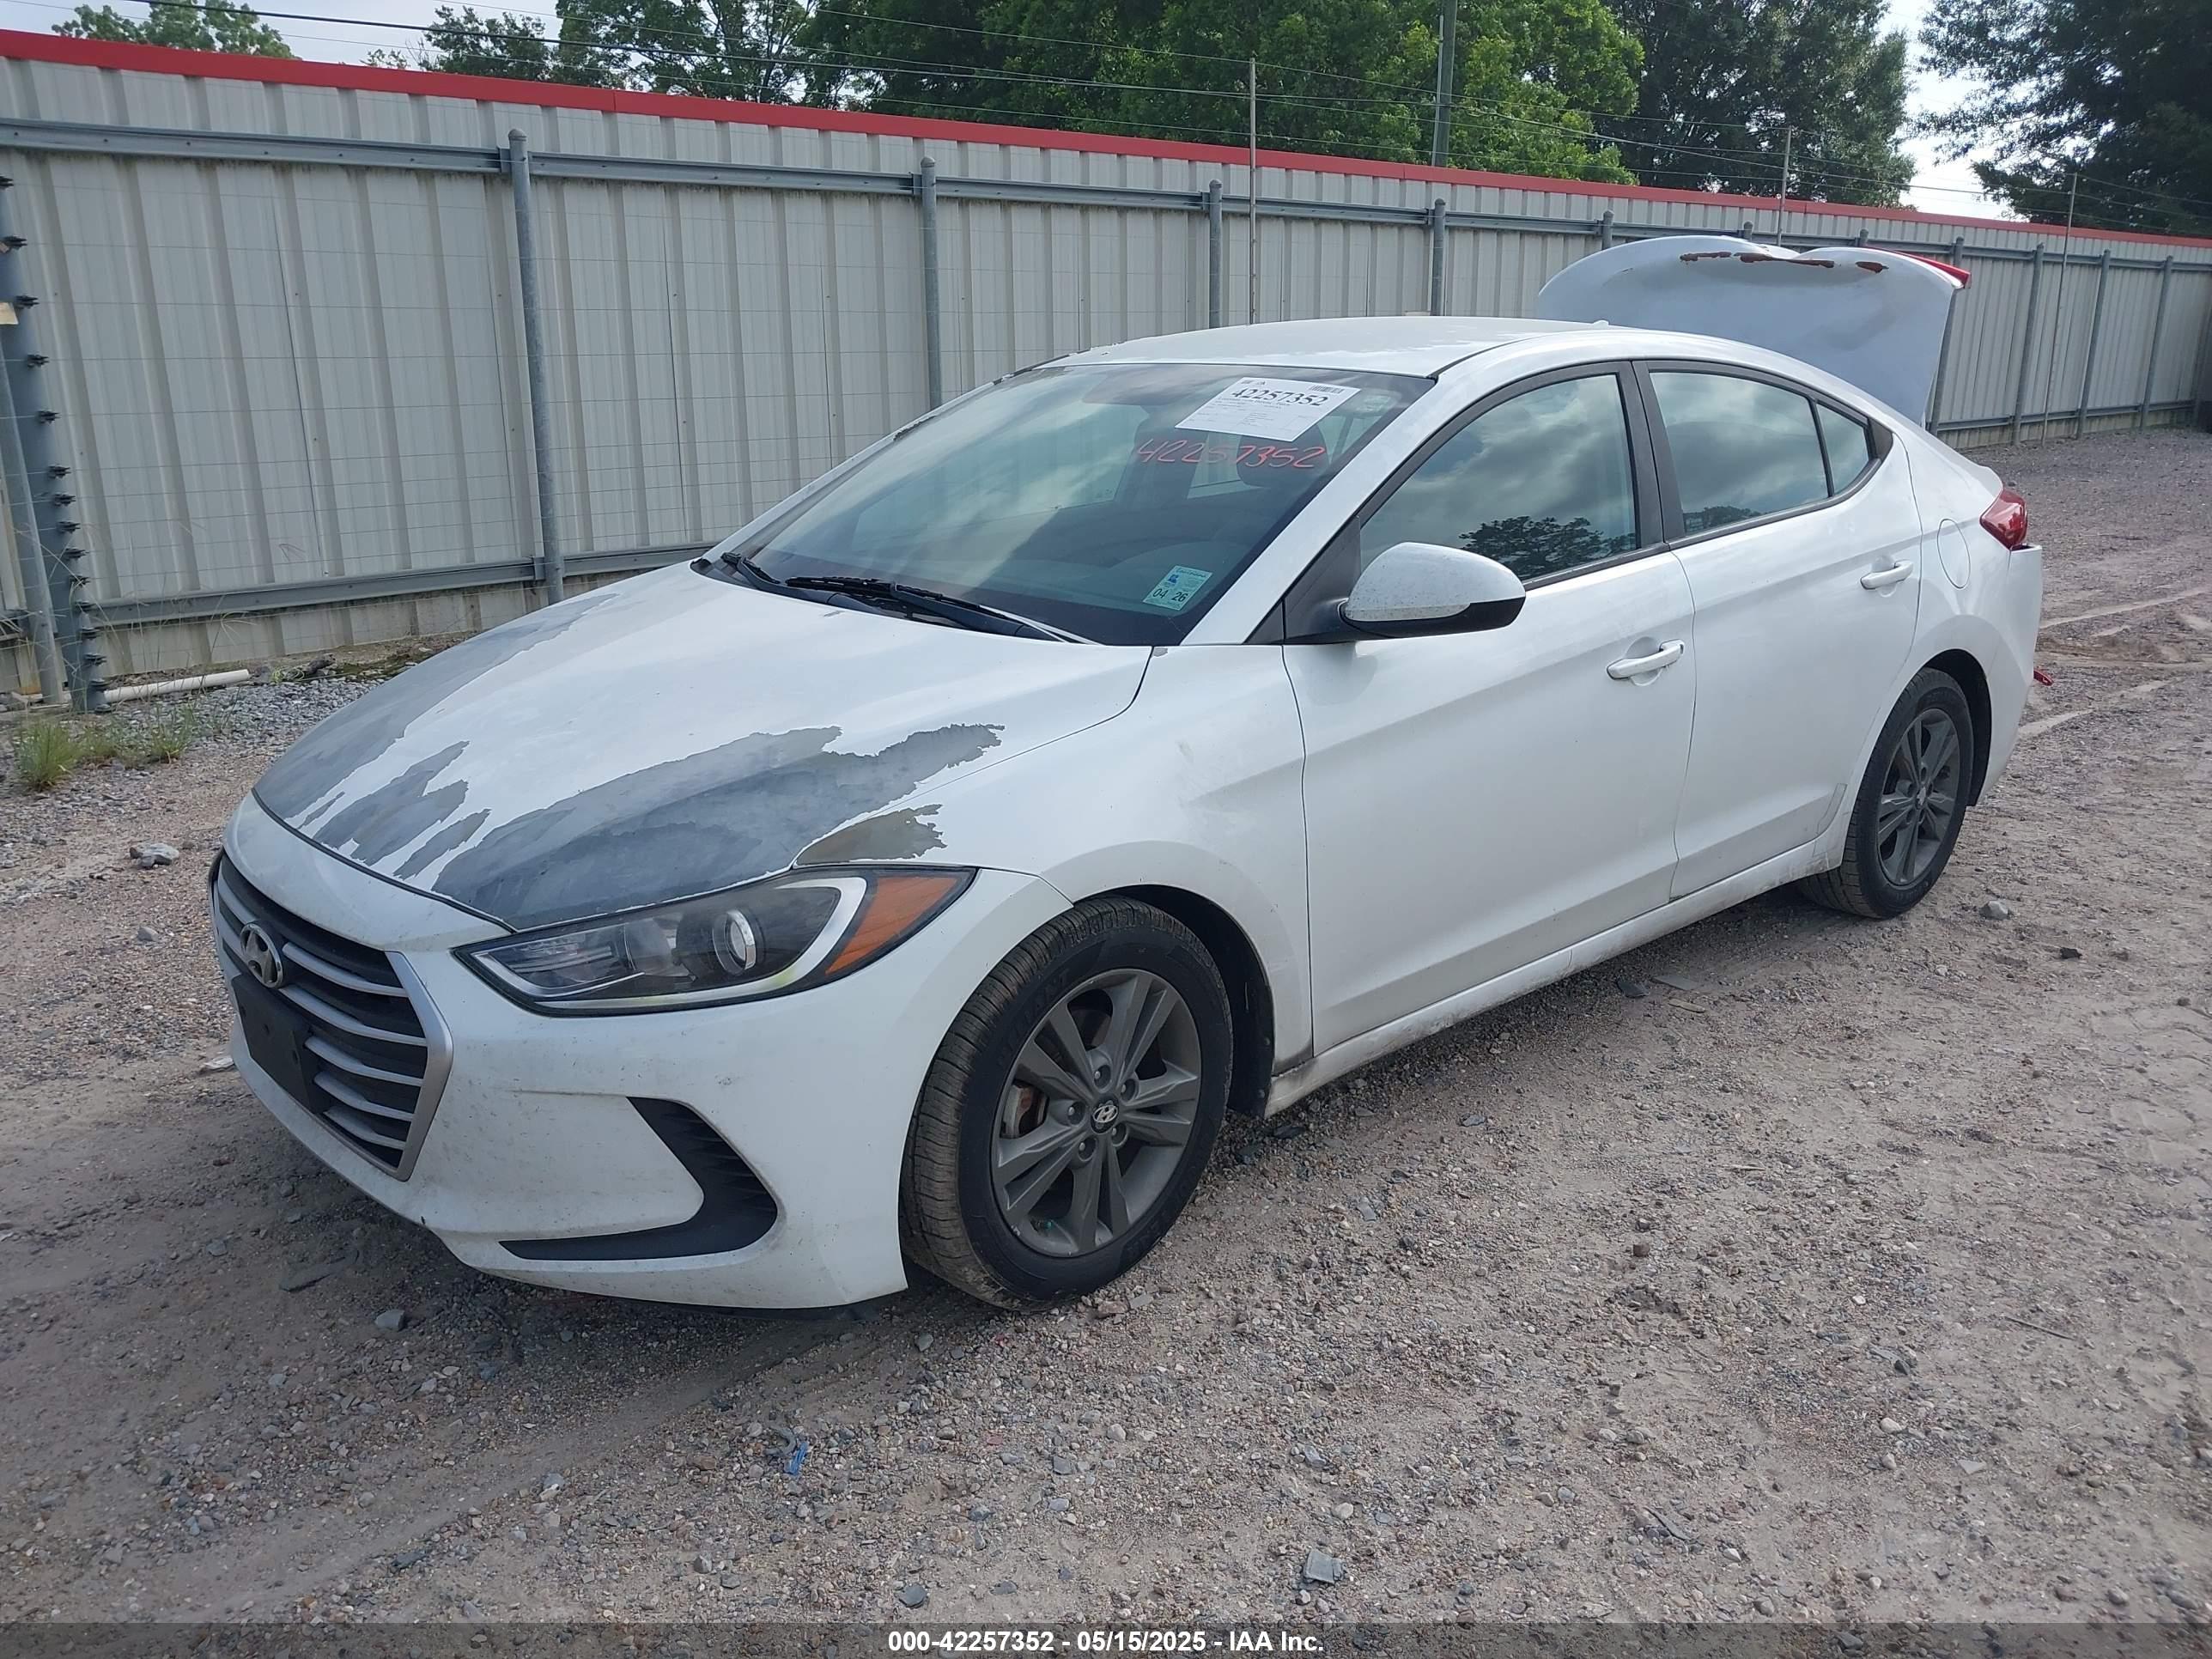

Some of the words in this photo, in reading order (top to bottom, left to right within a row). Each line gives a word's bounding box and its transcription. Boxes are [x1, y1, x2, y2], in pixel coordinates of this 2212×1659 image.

[1233, 388, 1329, 407] 42257352
[1137, 439, 1327, 469] 42257352
[1152, 588, 1169, 599] 04
[1171, 592, 1189, 603] 26
